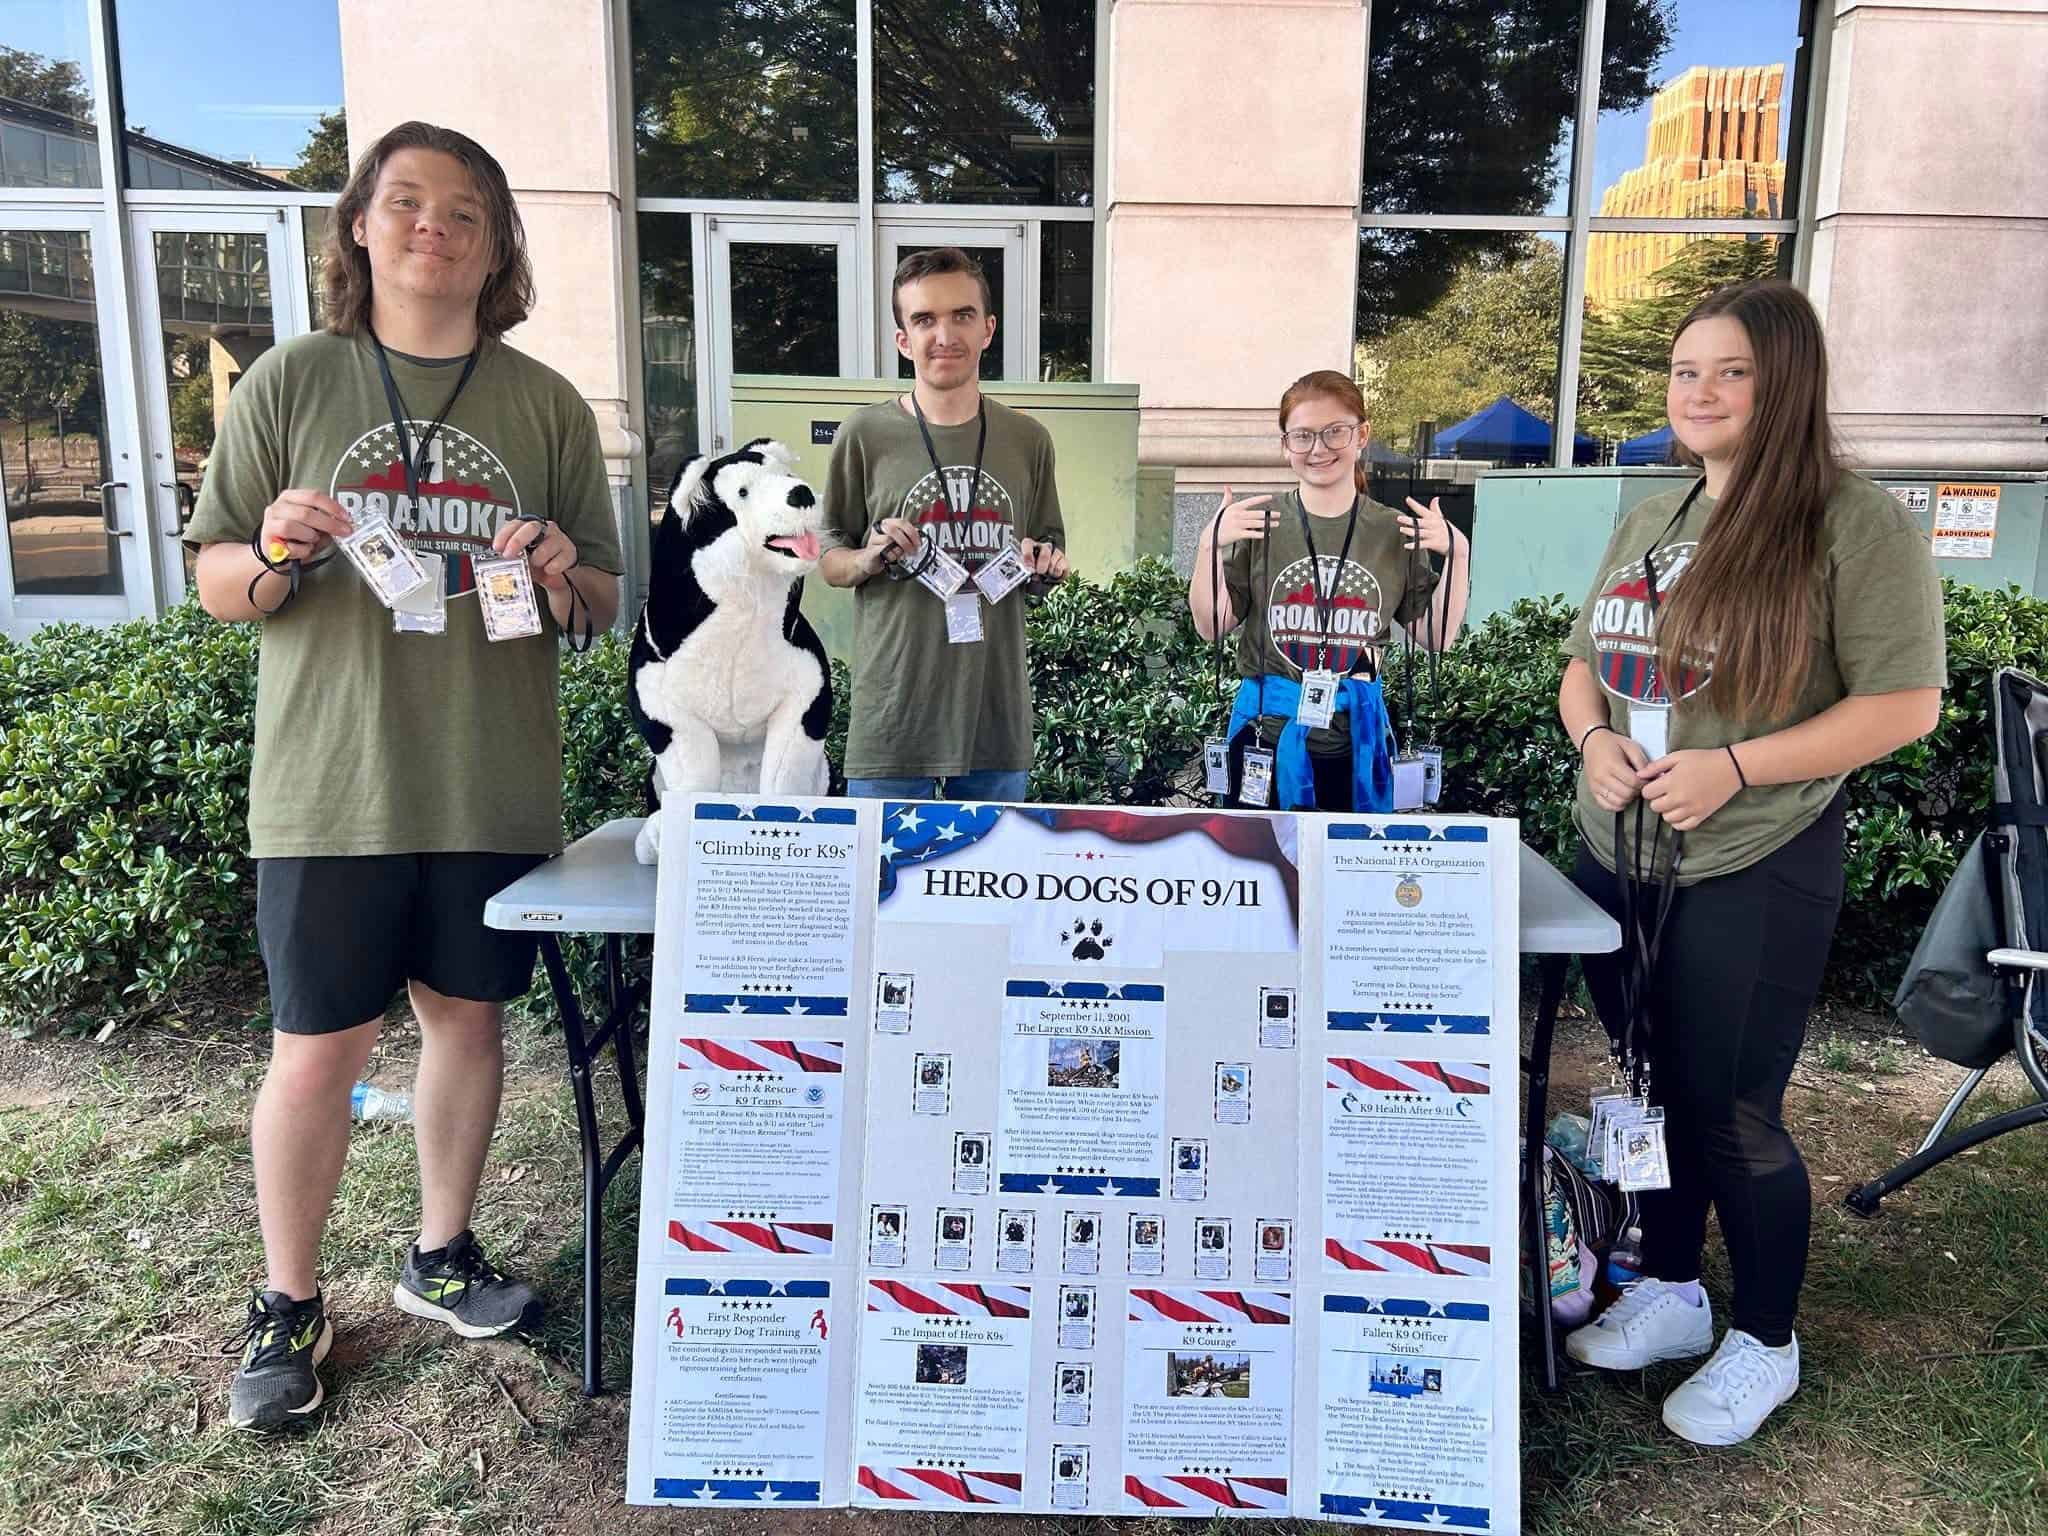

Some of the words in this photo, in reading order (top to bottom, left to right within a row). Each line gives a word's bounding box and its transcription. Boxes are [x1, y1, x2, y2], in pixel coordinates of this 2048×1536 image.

[1952, 488, 1996, 498] WARNING
[434, 542, 460, 551] STAIR
[787, 843, 812, 858] for
[1333, 856, 1353, 865] The
[1355, 856, 1396, 866] National
[1399, 857, 1418, 866] FFA
[1421, 858, 1485, 869] Organization
[923, 868, 1028, 899] HERO
[1036, 873, 1138, 904] DOGS
[1146, 878, 1196, 907] OF
[1202, 878, 1262, 907] 9/11
[1040, 1011, 1090, 1023] September
[1093, 1013, 1104, 1023] 11,
[1107, 1013, 1130, 1022] 2001
[1016, 1024, 1036, 1033] The
[1038, 1024, 1072, 1035] Largest
[1075, 1025, 1089, 1034] K9
[1091, 1026, 1112, 1035] SAR
[1114, 1026, 1151, 1036] Mission
[719, 1083, 750, 1093] Search
[753, 1084, 761, 1093] &
[764, 1084, 797, 1094] Rescue
[735, 1096, 748, 1105] K9
[751, 1097, 783, 1106] Teams
[1360, 1104, 1373, 1113] K9
[1375, 1104, 1407, 1115] Health
[1409, 1105, 1433, 1116] After
[1435, 1107, 1453, 1117] 9/11
[708, 1312, 730, 1322] First
[732, 1313, 786, 1324] Responder
[689, 1326, 731, 1337] Therapy
[734, 1327, 754, 1338] Dog
[758, 1328, 800, 1339] Training
[891, 1327, 910, 1336] The
[913, 1328, 946, 1339] Impact
[948, 1329, 959, 1338] of
[961, 1330, 984, 1340] Hero
[986, 1332, 1004, 1342] K9s
[1362, 1328, 1393, 1338] Fallen
[1395, 1330, 1409, 1340] K9
[1412, 1331, 1448, 1343] Officer
[1182, 1337, 1196, 1346] K9
[1198, 1338, 1237, 1348] Courage
